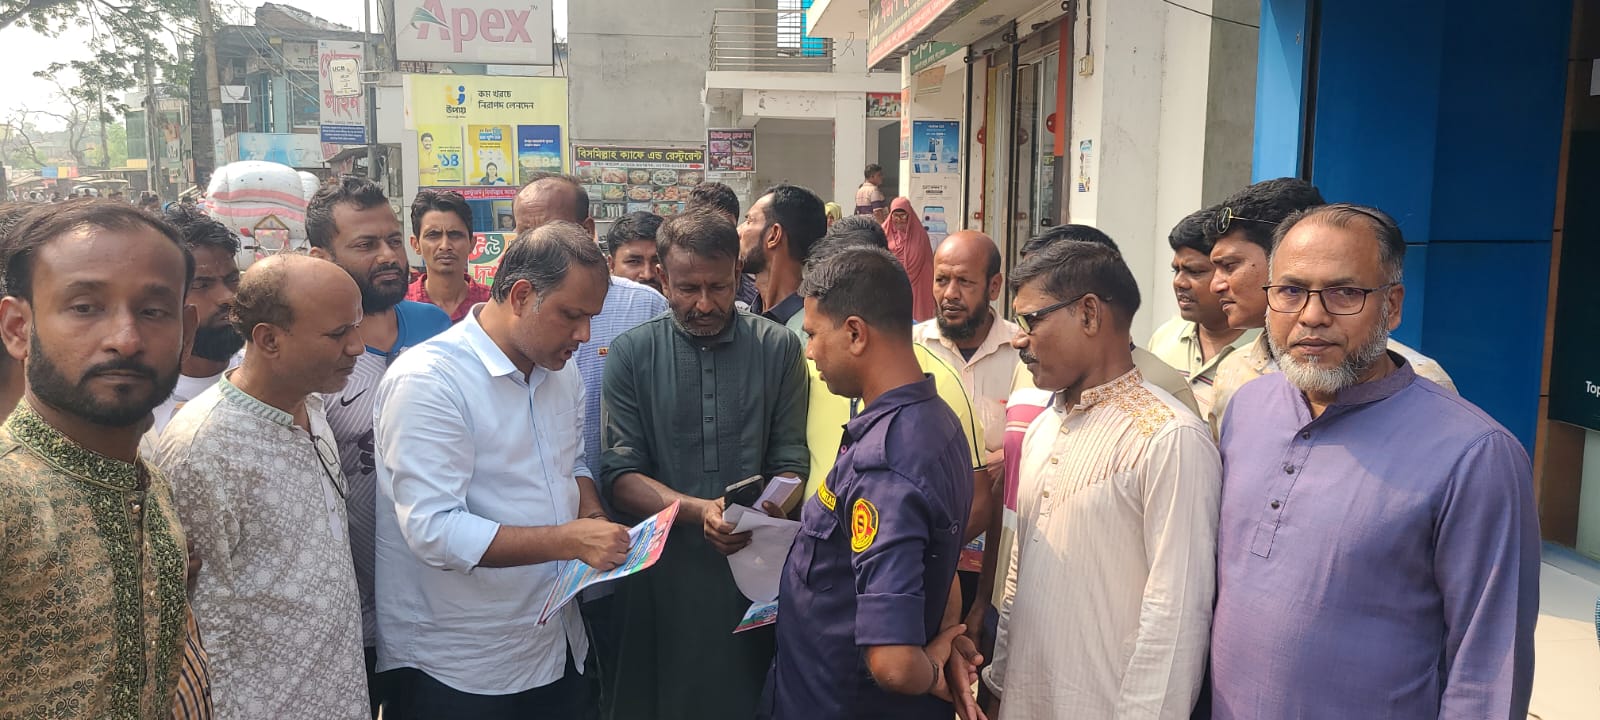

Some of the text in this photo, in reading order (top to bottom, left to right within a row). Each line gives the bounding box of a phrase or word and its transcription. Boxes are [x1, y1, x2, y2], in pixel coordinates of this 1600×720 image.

[415, 0, 533, 53] Apex
[478, 90, 492, 98] কম
[446, 105, 467, 114] উপায়
[478, 100, 534, 110] নিরাপদ লেনদেন
[441, 153, 460, 167] ১৪
[577, 147, 617, 160] বিসমিল্লাহ
[619, 149, 645, 160] ক্যাফে
[647, 151, 663, 161] এন্ড
